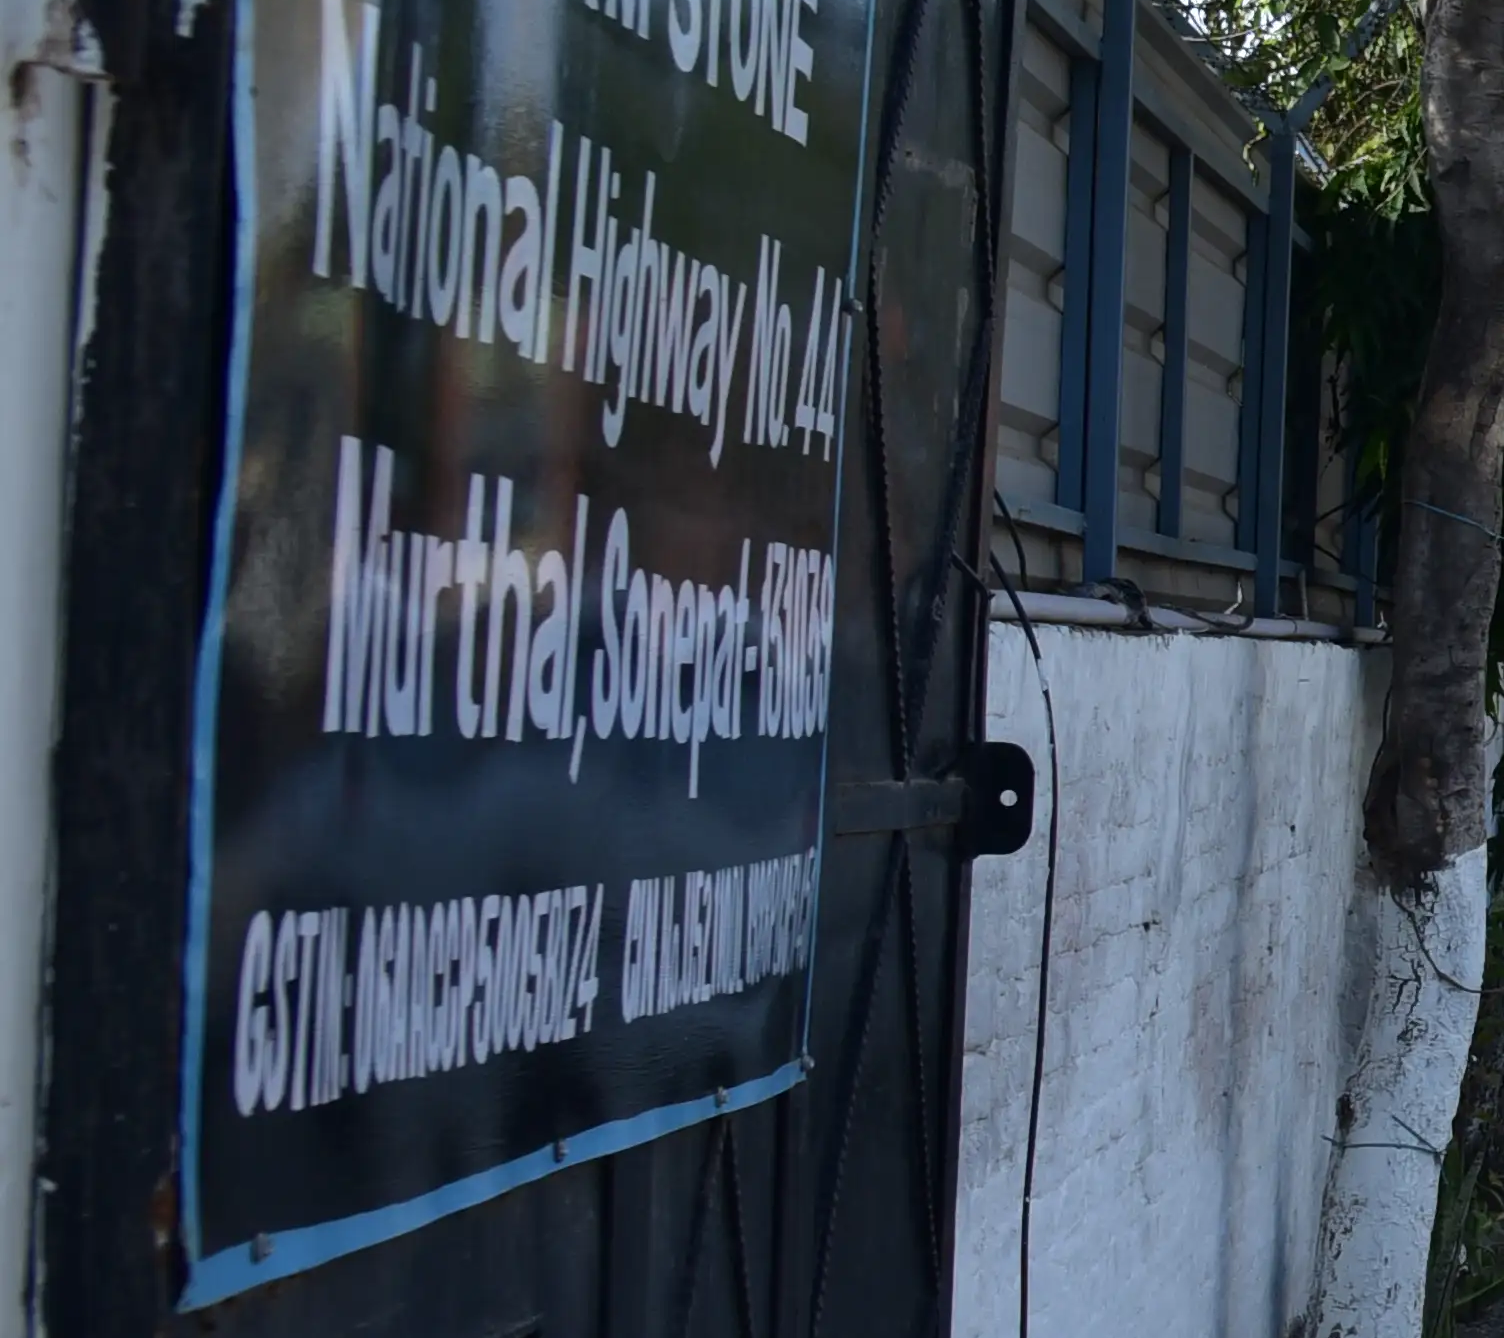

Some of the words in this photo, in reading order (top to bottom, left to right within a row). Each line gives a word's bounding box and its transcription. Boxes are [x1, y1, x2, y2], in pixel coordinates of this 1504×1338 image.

[561, 135, 747, 470] Highway
[743, 233, 792, 448] No.
[795, 265, 843, 462] 44
